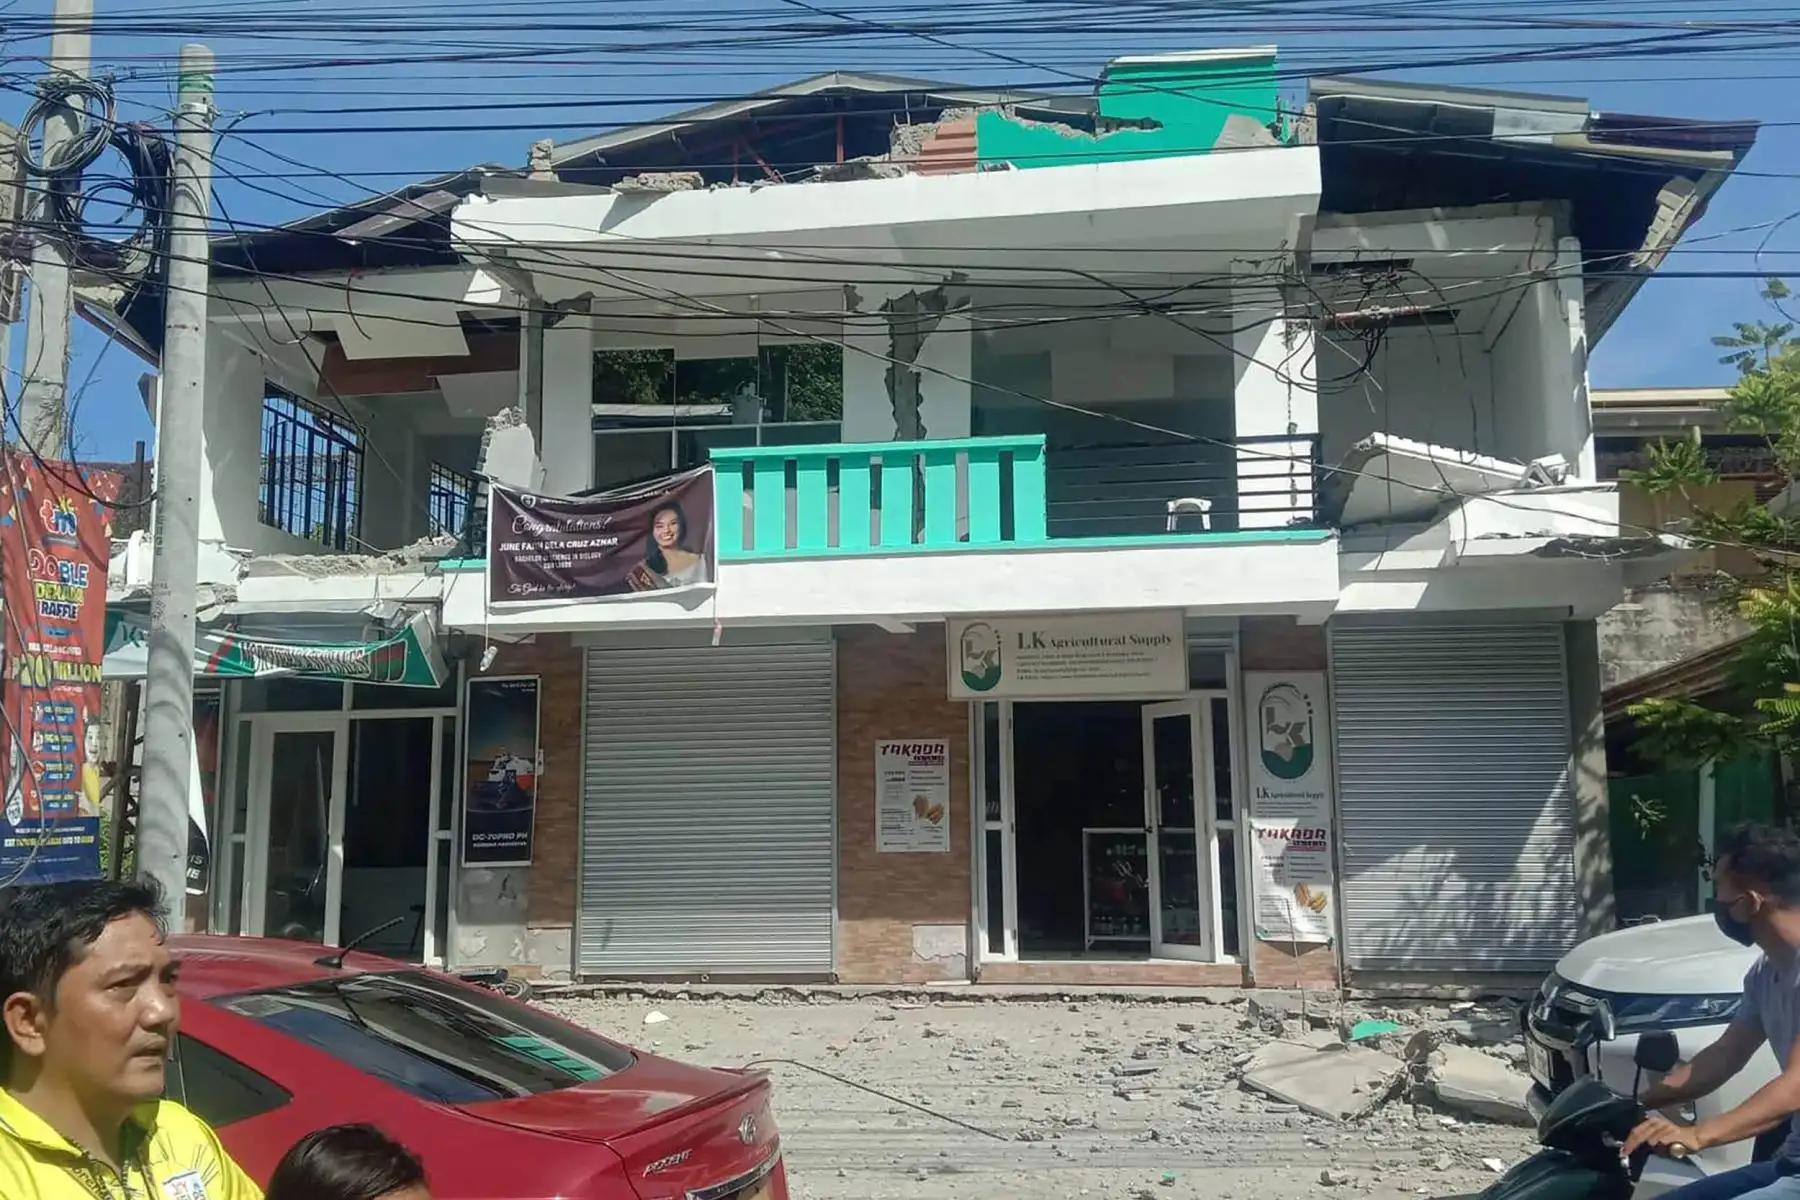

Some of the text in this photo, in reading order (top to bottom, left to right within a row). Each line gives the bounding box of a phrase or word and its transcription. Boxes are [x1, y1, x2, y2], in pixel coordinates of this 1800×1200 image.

[499, 542, 520, 551] JUNE
[566, 539, 588, 549] CRUZ
[590, 537, 618, 547] AZNAR
[40, 600, 78, 620] RAFFLE
[1017, 631, 1172, 650] LK Agricultural Supply
